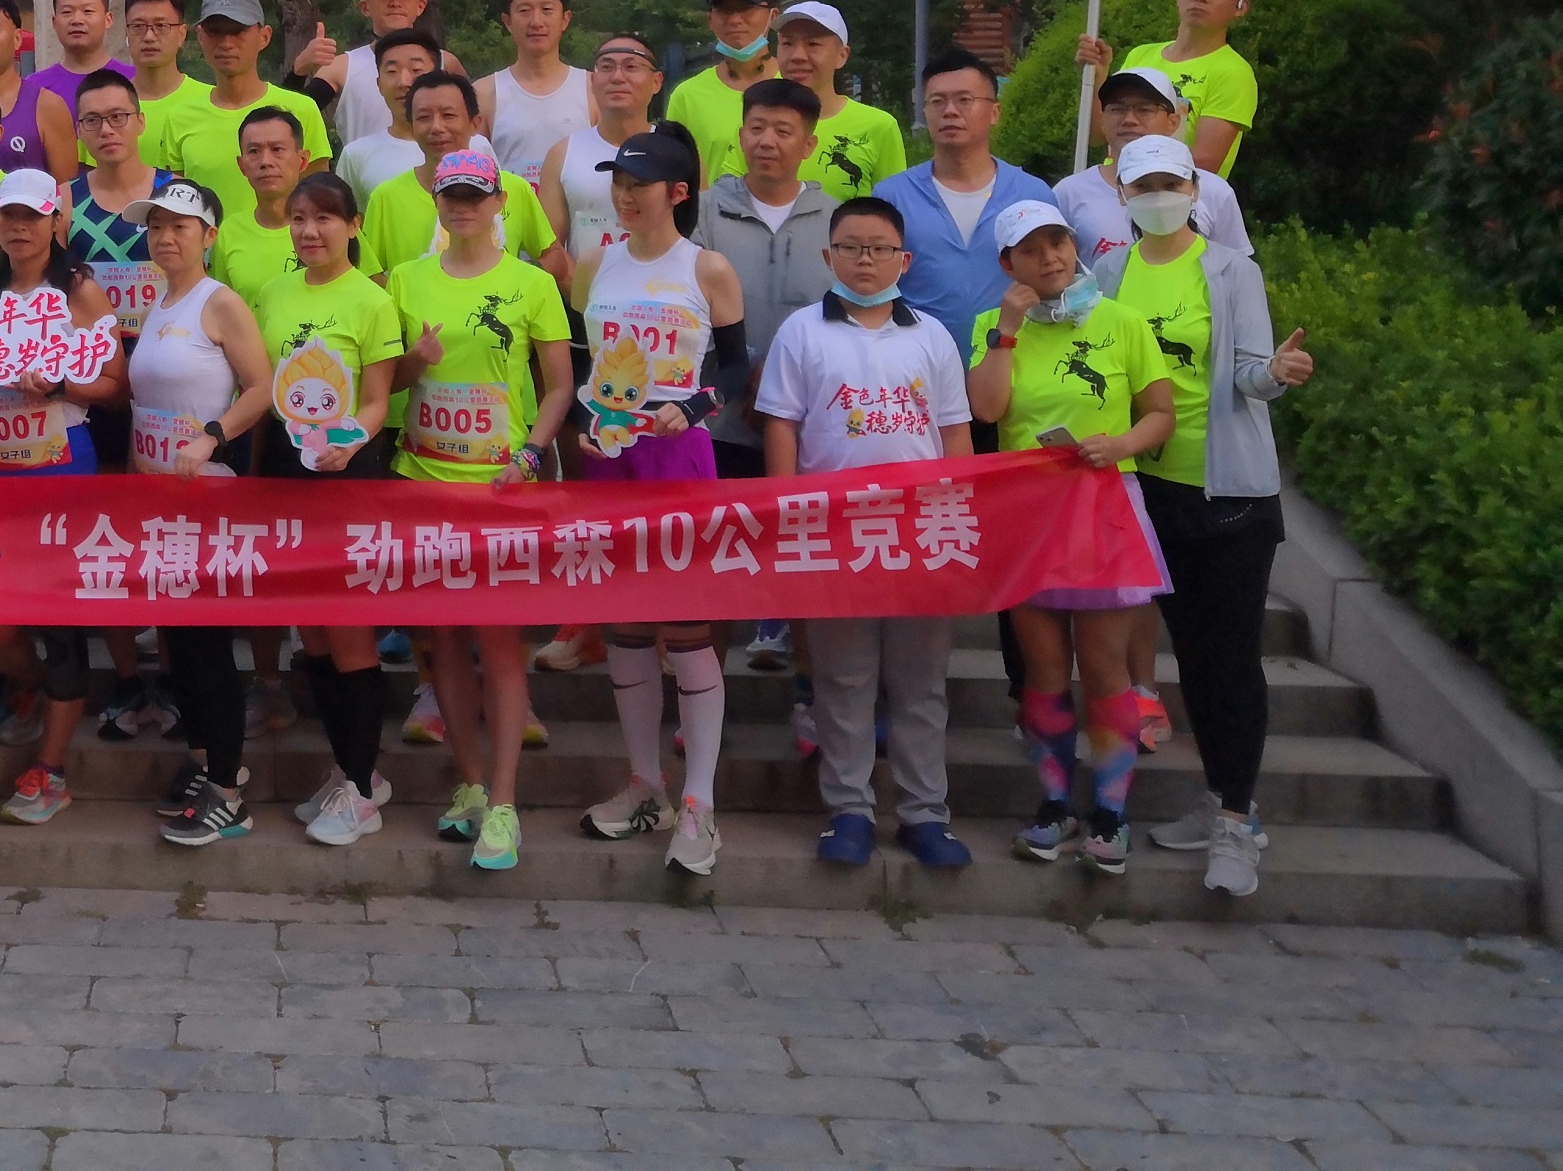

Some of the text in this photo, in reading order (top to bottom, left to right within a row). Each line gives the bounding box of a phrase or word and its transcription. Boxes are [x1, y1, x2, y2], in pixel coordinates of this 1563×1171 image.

[826, 383, 910, 413] 金色年华
[419, 401, 492, 434] B005
[865, 410, 930, 436] 穗岁守护
[0, 449, 31, 460] 女子组
[436, 441, 469, 454] 女子组
